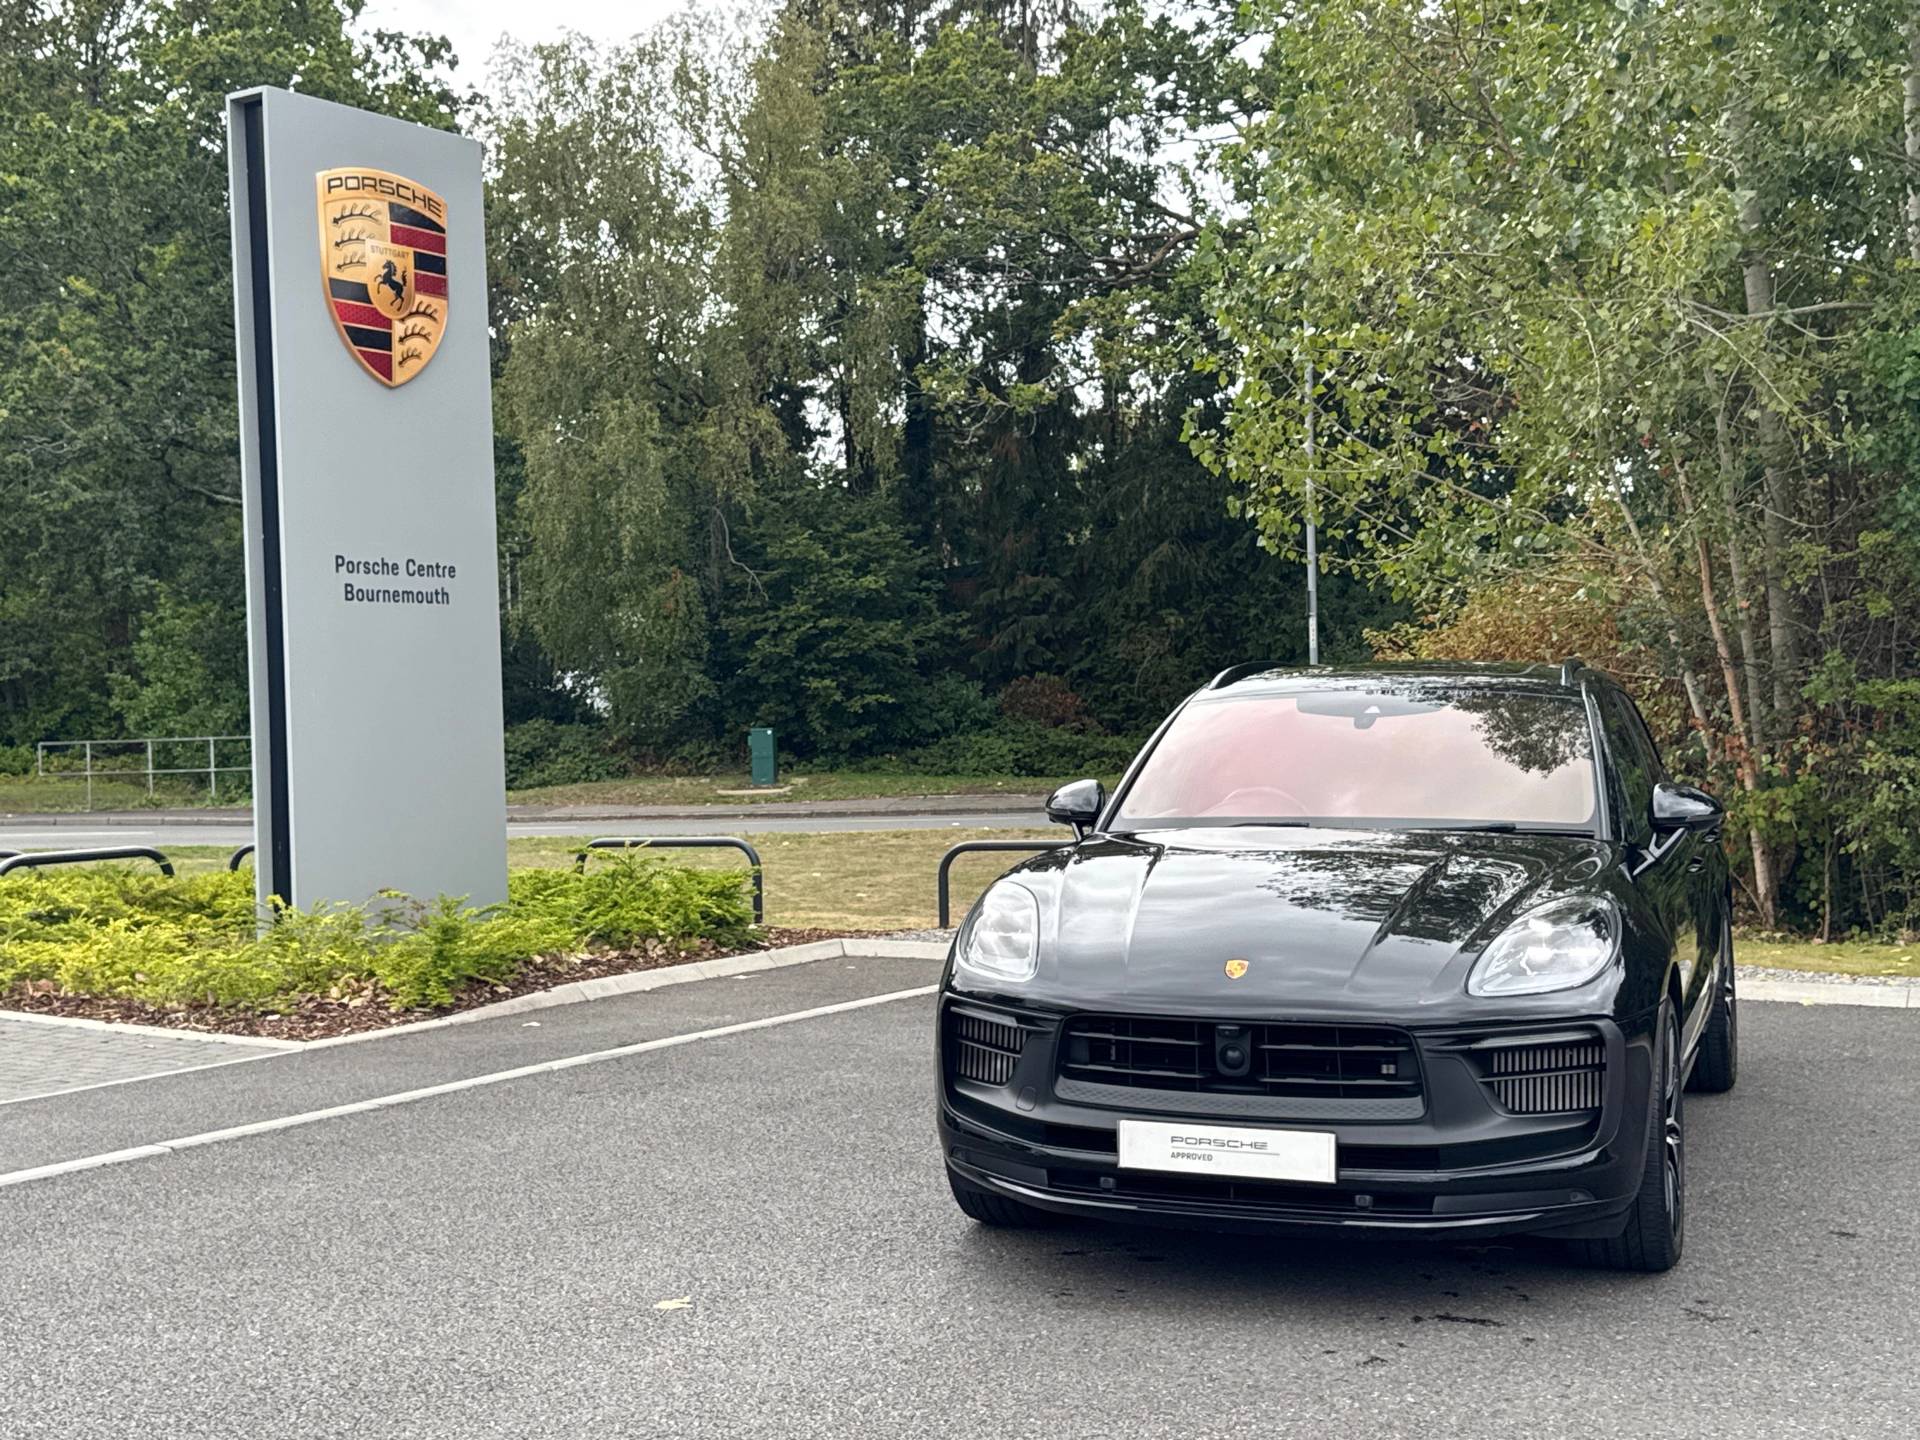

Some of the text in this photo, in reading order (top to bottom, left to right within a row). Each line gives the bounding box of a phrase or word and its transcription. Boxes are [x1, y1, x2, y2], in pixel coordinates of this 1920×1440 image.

[327, 176, 442, 218] PORSCHE
[370, 244, 410, 259] STUTTGART
[335, 555, 456, 579] Porsche Centre
[344, 583, 450, 605] Bournemouth
[1170, 1135, 1268, 1150] PORSCHE
[1170, 1151, 1213, 1162] APPROVED
